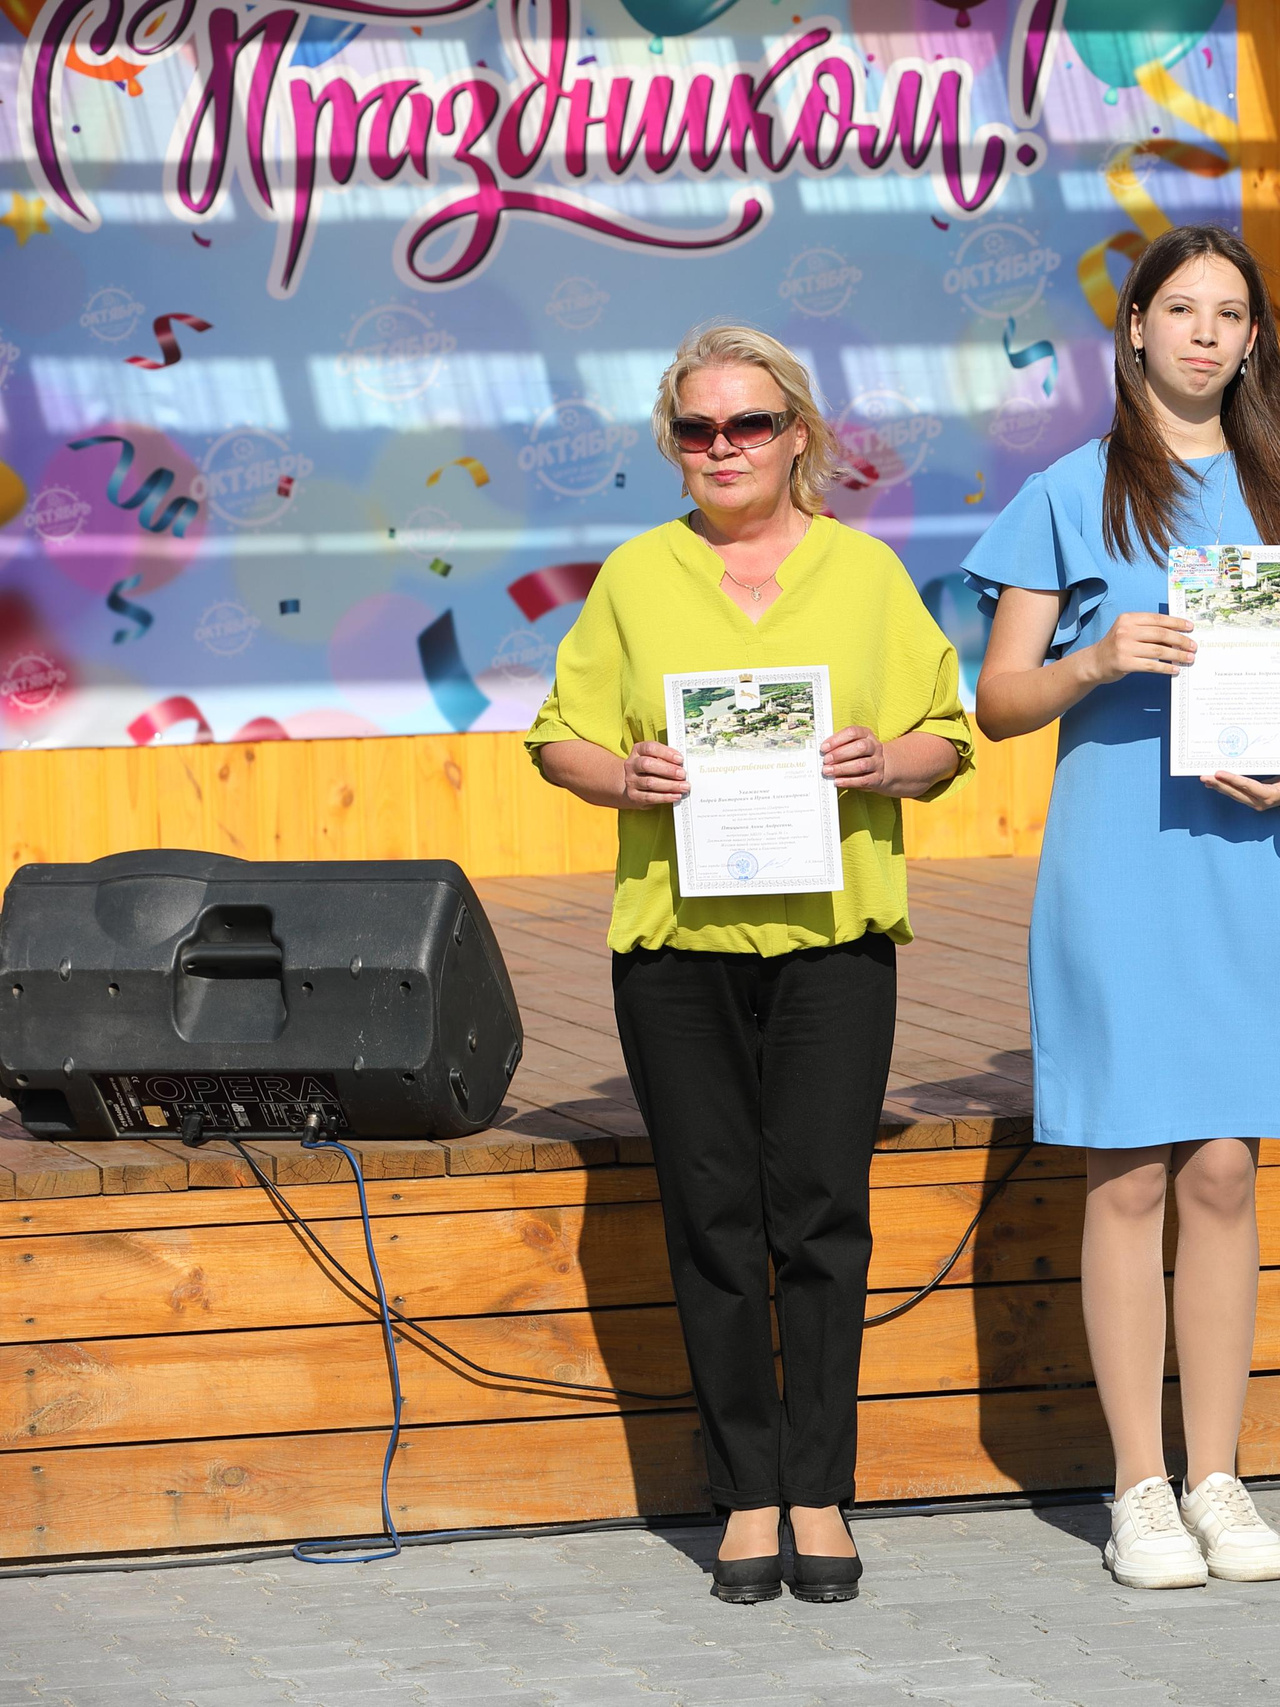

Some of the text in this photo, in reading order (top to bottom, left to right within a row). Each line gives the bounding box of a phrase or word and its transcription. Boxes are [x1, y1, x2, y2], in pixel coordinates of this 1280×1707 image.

[778, 265, 863, 298] ОКТЯБРЬ
[943, 247, 1062, 294] ОКТЯБРЬ
[80, 301, 146, 327] ОКТЯБРЬ
[517, 426, 639, 472] ОКТЯБРЬ
[838, 416, 943, 454] КТЯБРЬ
[190, 453, 314, 501] ОКТЯБРЬ
[699, 761, 806, 774] Благодарственное письмо
[145, 1076, 338, 1103] OPERA
